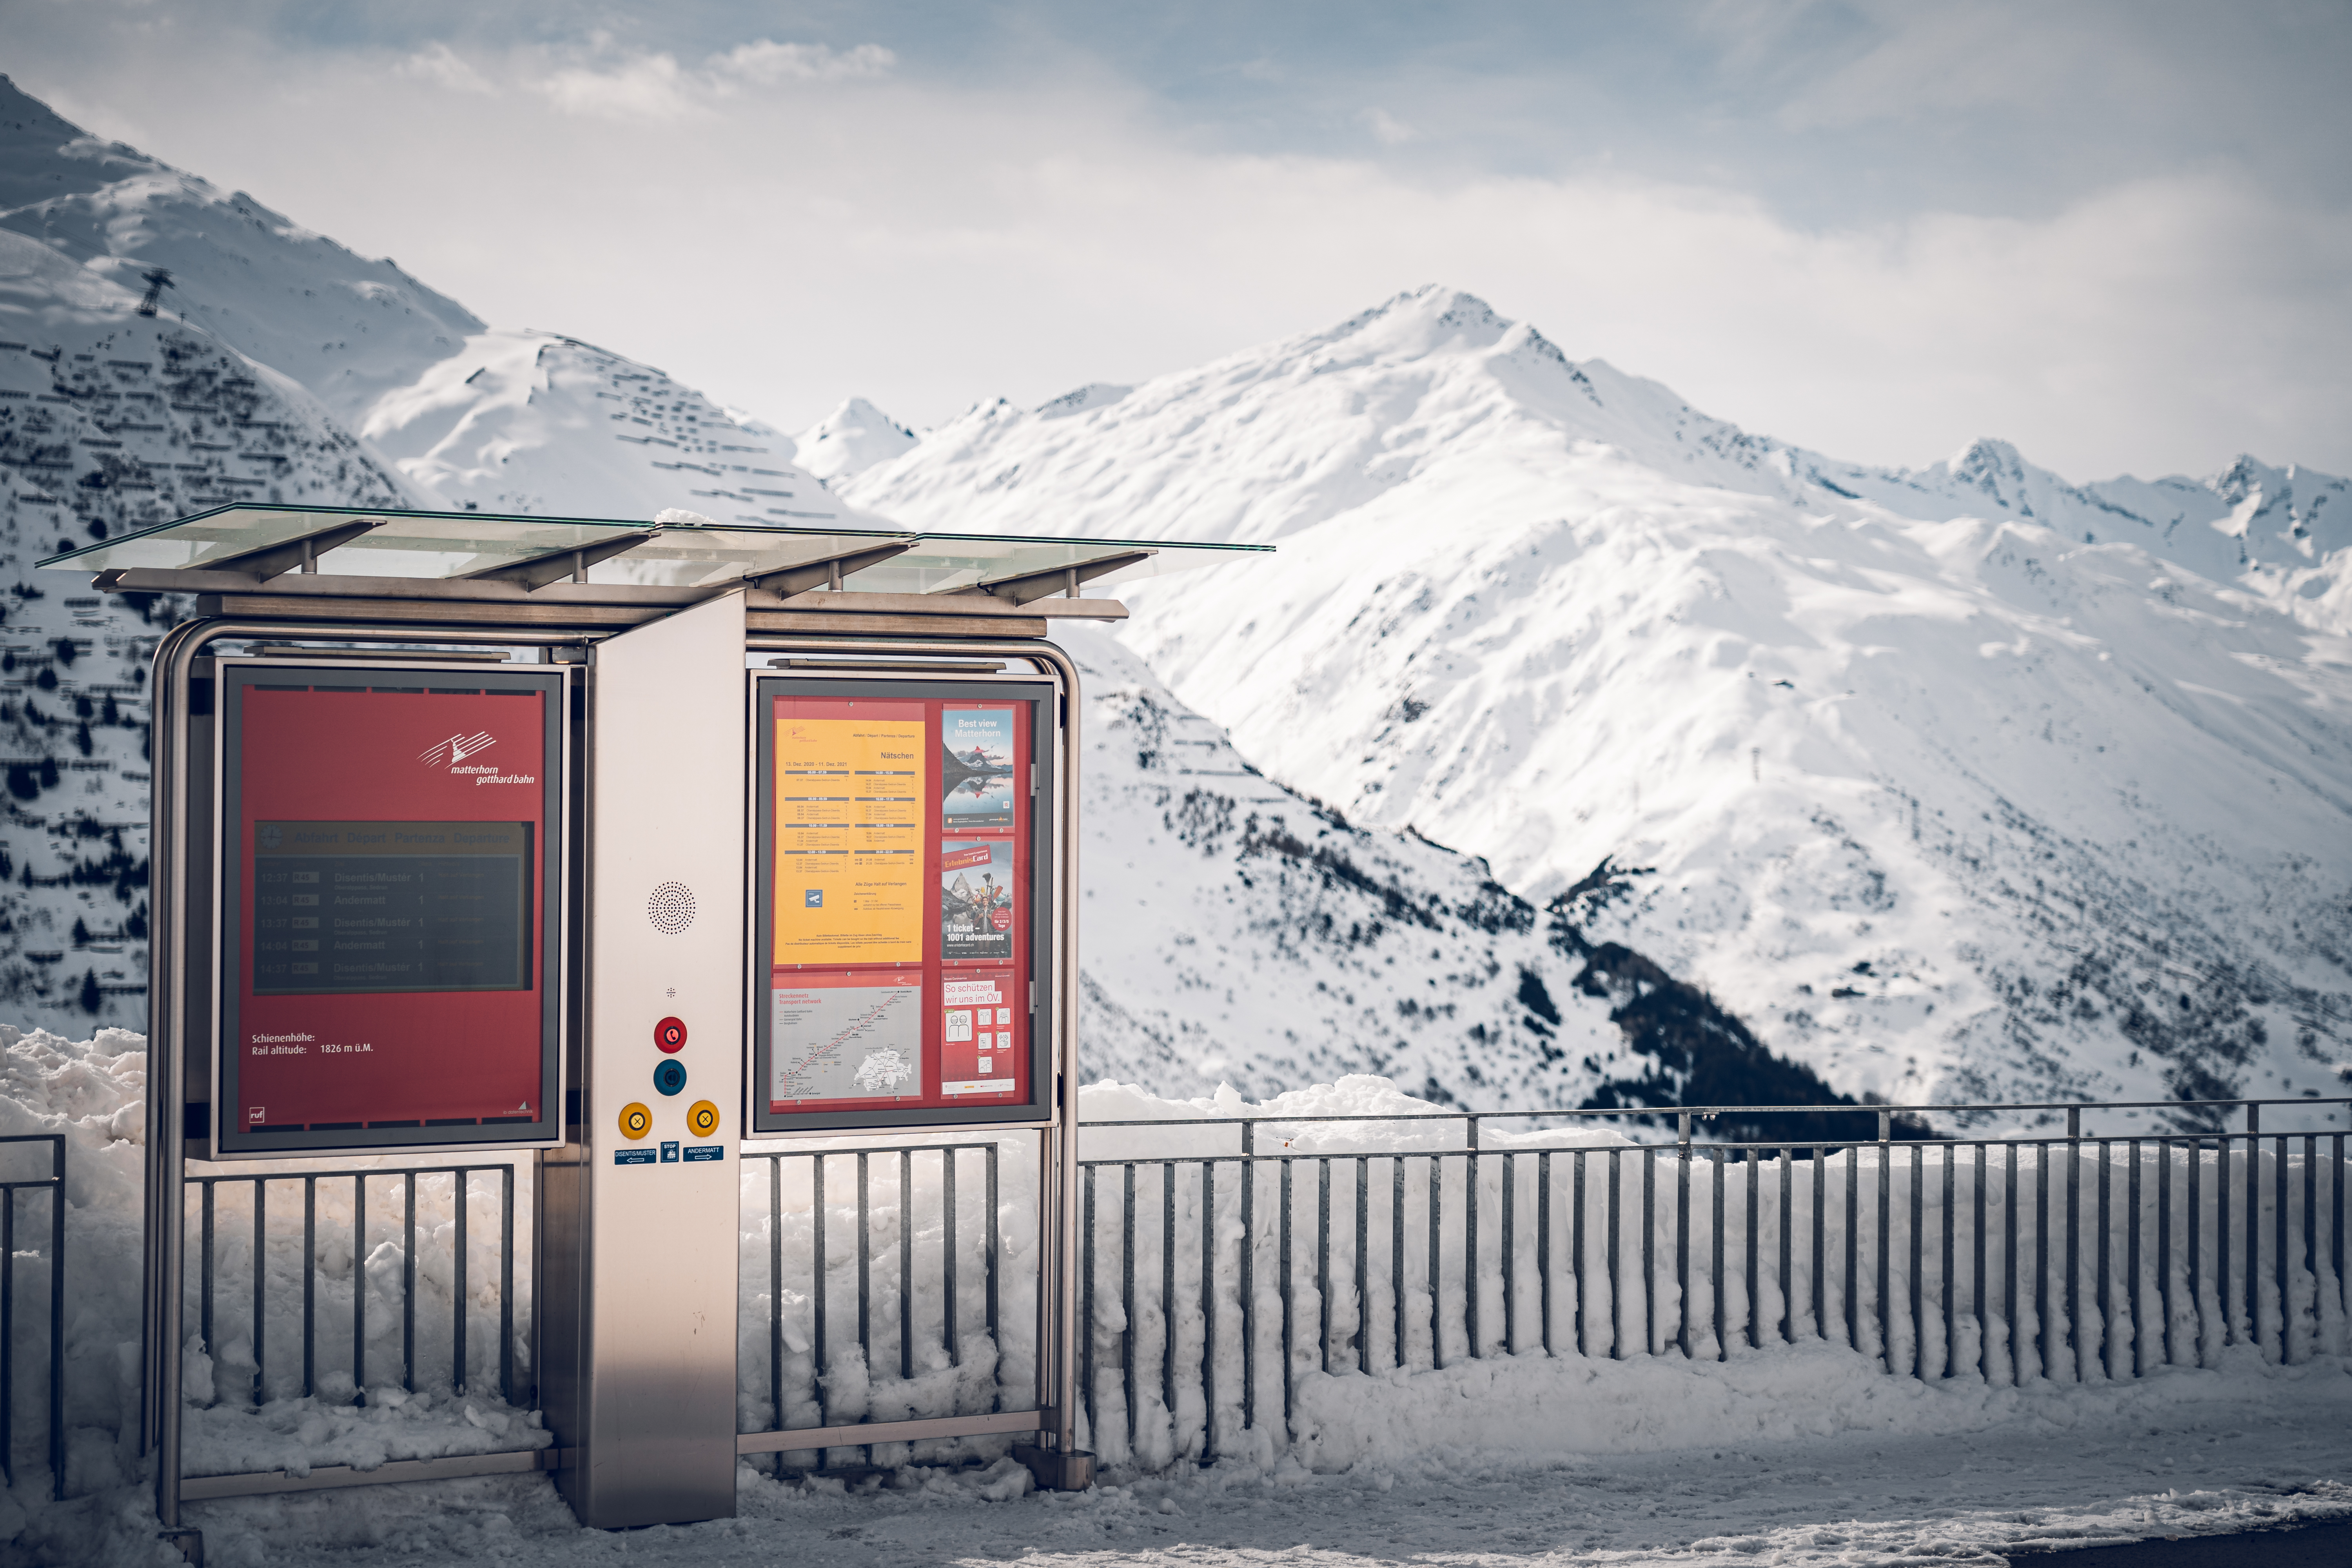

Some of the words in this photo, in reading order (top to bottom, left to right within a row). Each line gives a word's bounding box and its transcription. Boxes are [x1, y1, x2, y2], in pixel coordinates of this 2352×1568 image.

[958, 719, 976, 728] Best
[978, 719, 997, 727] view
[955, 729, 1001, 737] Matterhorn
[451, 765, 498, 774] matterhorn
[476, 774, 513, 786] gotthard
[513, 774, 534, 784] bahn
[295, 832, 338, 843] Abfahrt
[347, 832, 386, 845] Départ
[395, 833, 445, 843] Partenza
[454, 833, 510, 846] Departure
[945, 853, 988, 867] ErlebnisCard
[262, 873, 288, 882] 12:37
[335, 873, 411, 882] Disentis/Mustér
[419, 873, 423, 882] 1
[261, 896, 287, 905] 13:04
[334, 896, 386, 904] Andermatt
[419, 895, 423, 905] 1
[261, 919, 287, 928] 13:37
[334, 918, 411, 927] Disentis/Mustér
[418, 918, 423, 927] 1
[953, 924, 974, 932] ticket
[965, 933, 1004, 941] adventures
[261, 942, 287, 951] 14:04
[334, 941, 385, 949] Andermatt
[418, 940, 423, 949] 1
[260, 964, 287, 973] 14:37
[334, 963, 410, 972] Disentis/Mustér
[418, 963, 422, 972] 1
[946, 984, 956, 993] So
[958, 984, 993, 992] schützen
[946, 995, 957, 1004] wir
[987, 992, 1000, 1002] ÖV.
[252, 1033, 315, 1043] Schienenhöhe:
[252, 1045, 268, 1055] Rail
[271, 1045, 307, 1054] altitude:
[320, 1045, 341, 1053] 1826
[355, 1043, 373, 1052] ü.M.
